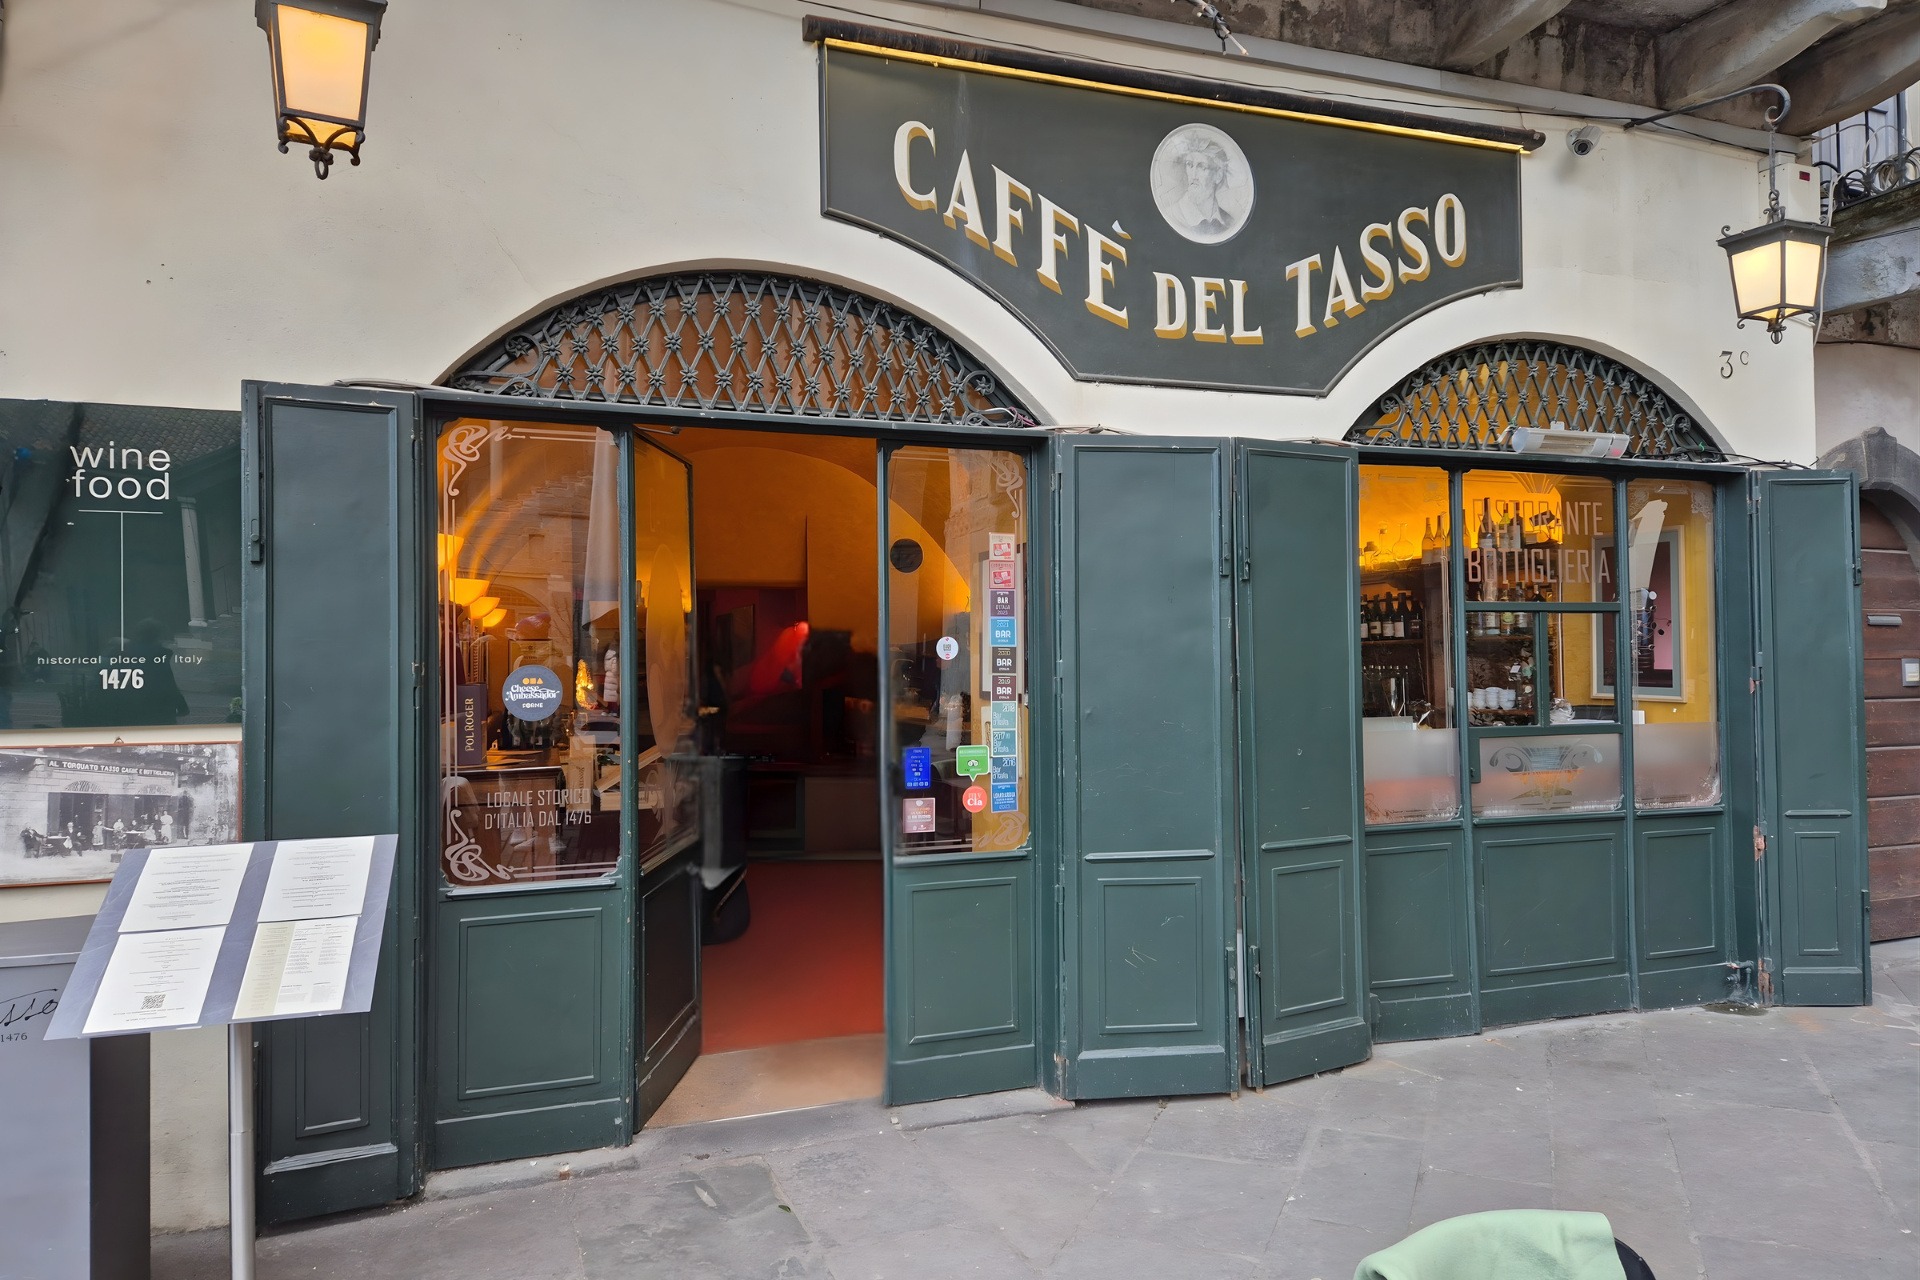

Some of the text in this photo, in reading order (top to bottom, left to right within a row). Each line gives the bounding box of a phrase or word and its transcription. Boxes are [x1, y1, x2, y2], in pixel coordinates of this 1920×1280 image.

[894, 120, 1467, 345] CAFFÈ DEL TASSO
[70, 440, 171, 472] wine
[71, 469, 171, 500] food
[1472, 499, 1604, 537] RISTORANTE
[1468, 548, 1611, 584] BOTTIGLIERIA
[995, 630, 1011, 638] BAR
[37, 653, 203, 666] historical place of Italy
[996, 658, 1012, 667] BAR
[99, 668, 144, 690] 1476
[996, 686, 1012, 695] BAR
[464, 698, 475, 752] POL ROGER
[48, 760, 60, 768] AL
[62, 761, 99, 771] TORQUATO
[101, 765, 120, 773] TASSO
[487, 787, 590, 809] LOCALE STORICO
[484, 809, 592, 831] D'ITALIA DAL 1476
[0, 1032, 28, 1042] 1476
